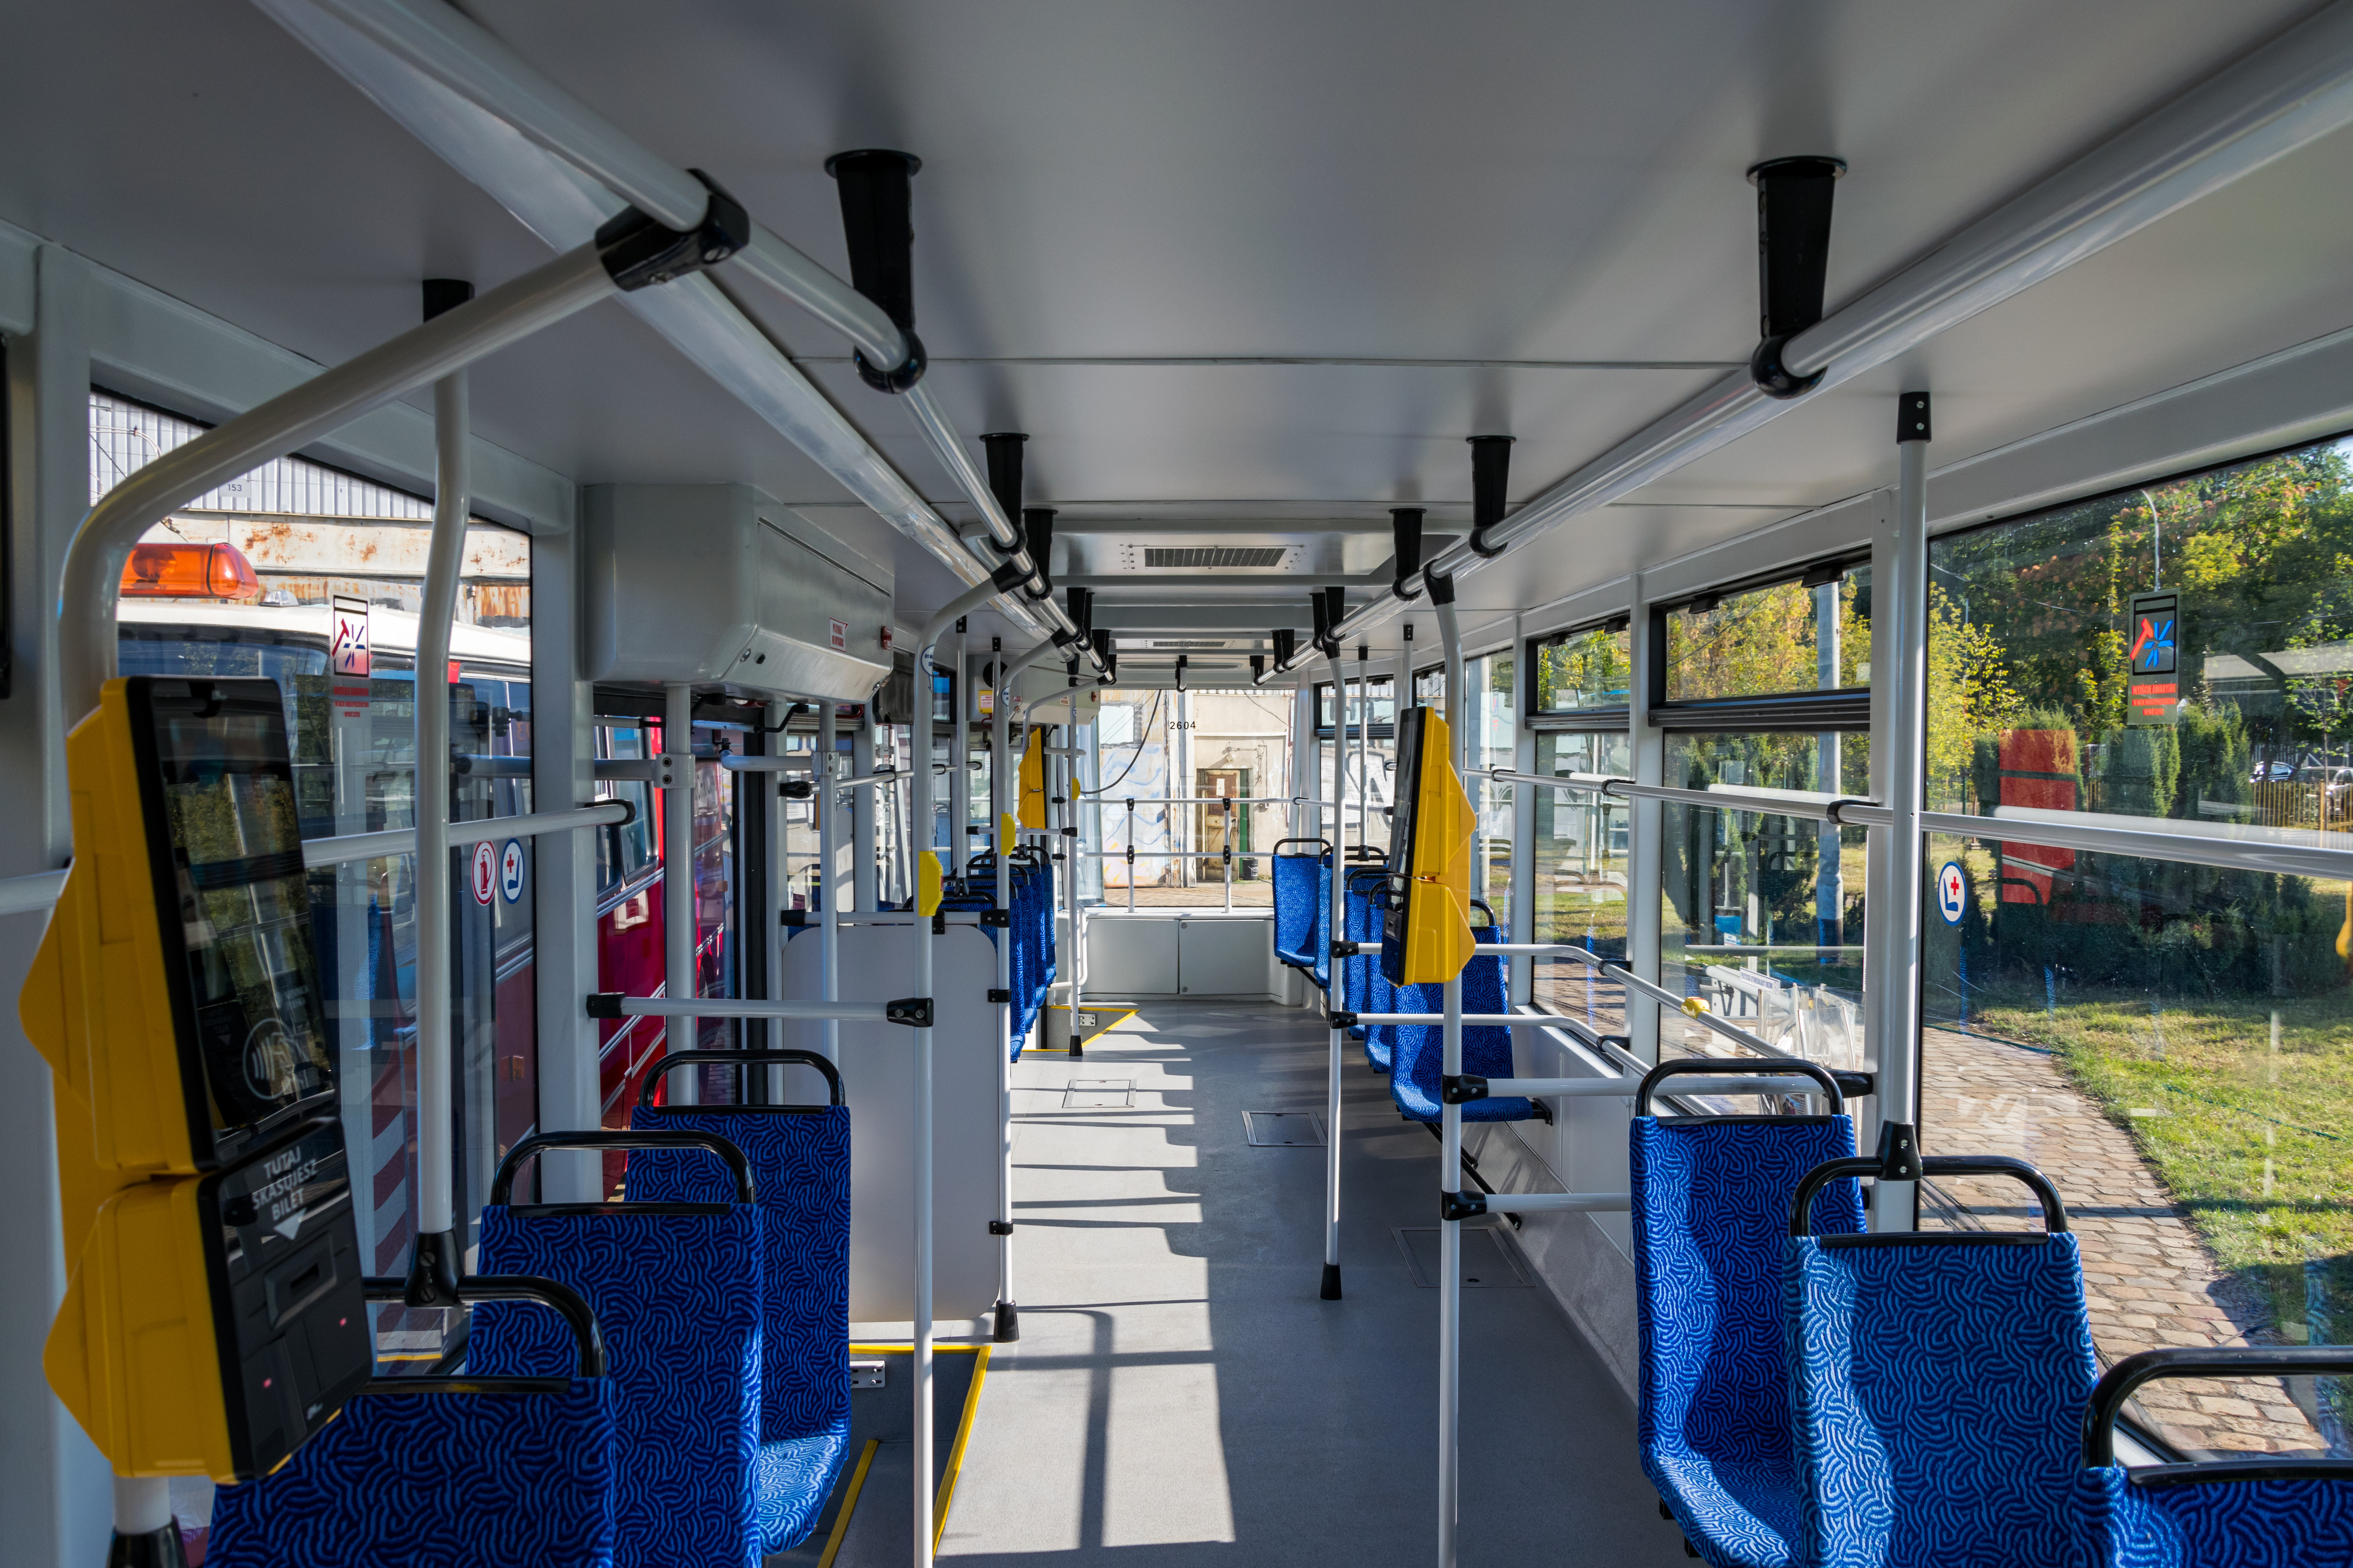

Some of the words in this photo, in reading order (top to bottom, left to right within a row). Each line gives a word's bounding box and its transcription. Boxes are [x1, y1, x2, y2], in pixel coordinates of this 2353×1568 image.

[1170, 721, 1196, 729] 2604
[263, 1146, 301, 1179] TUTAJ
[252, 1158, 318, 1210] SKASUJESZ
[272, 1188, 304, 1221] BILET
